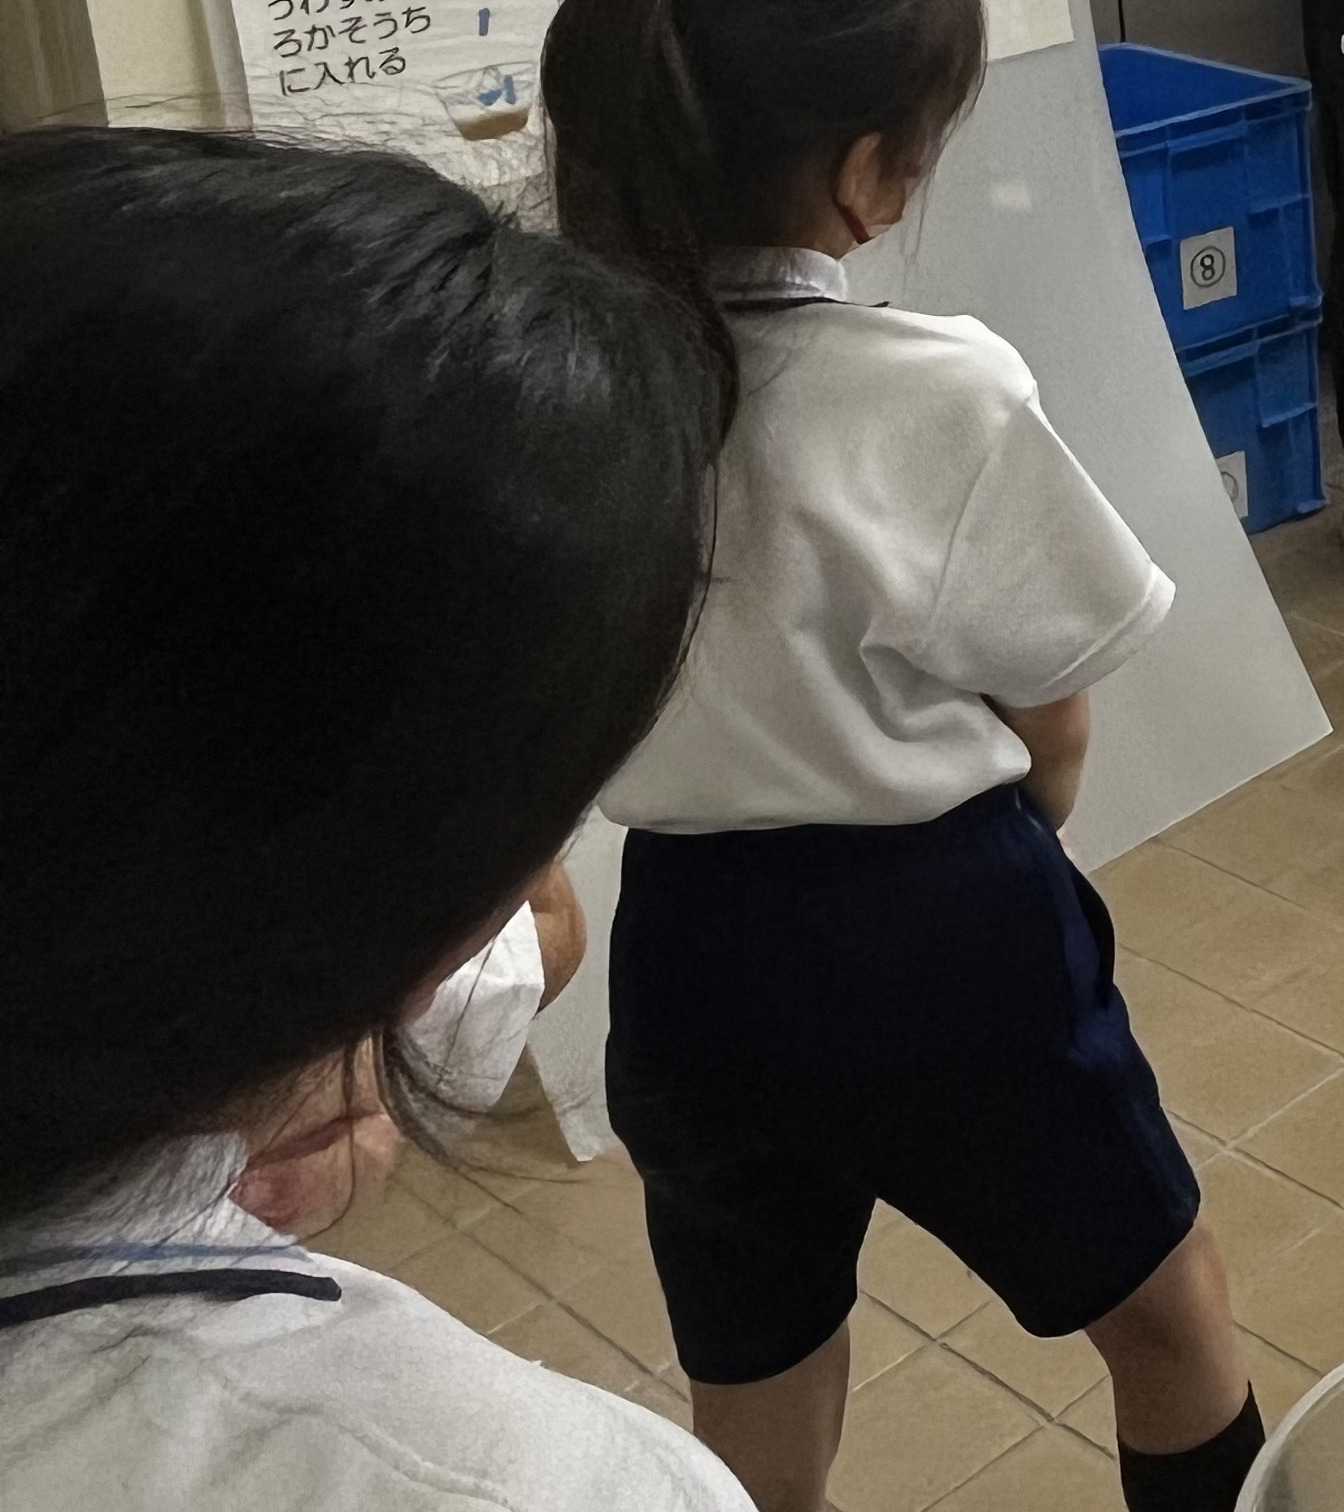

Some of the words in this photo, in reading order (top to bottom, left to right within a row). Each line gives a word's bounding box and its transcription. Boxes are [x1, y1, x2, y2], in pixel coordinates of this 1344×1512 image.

[273, 6, 432, 59] ろかそうち
[279, 46, 407, 97] に入れる
